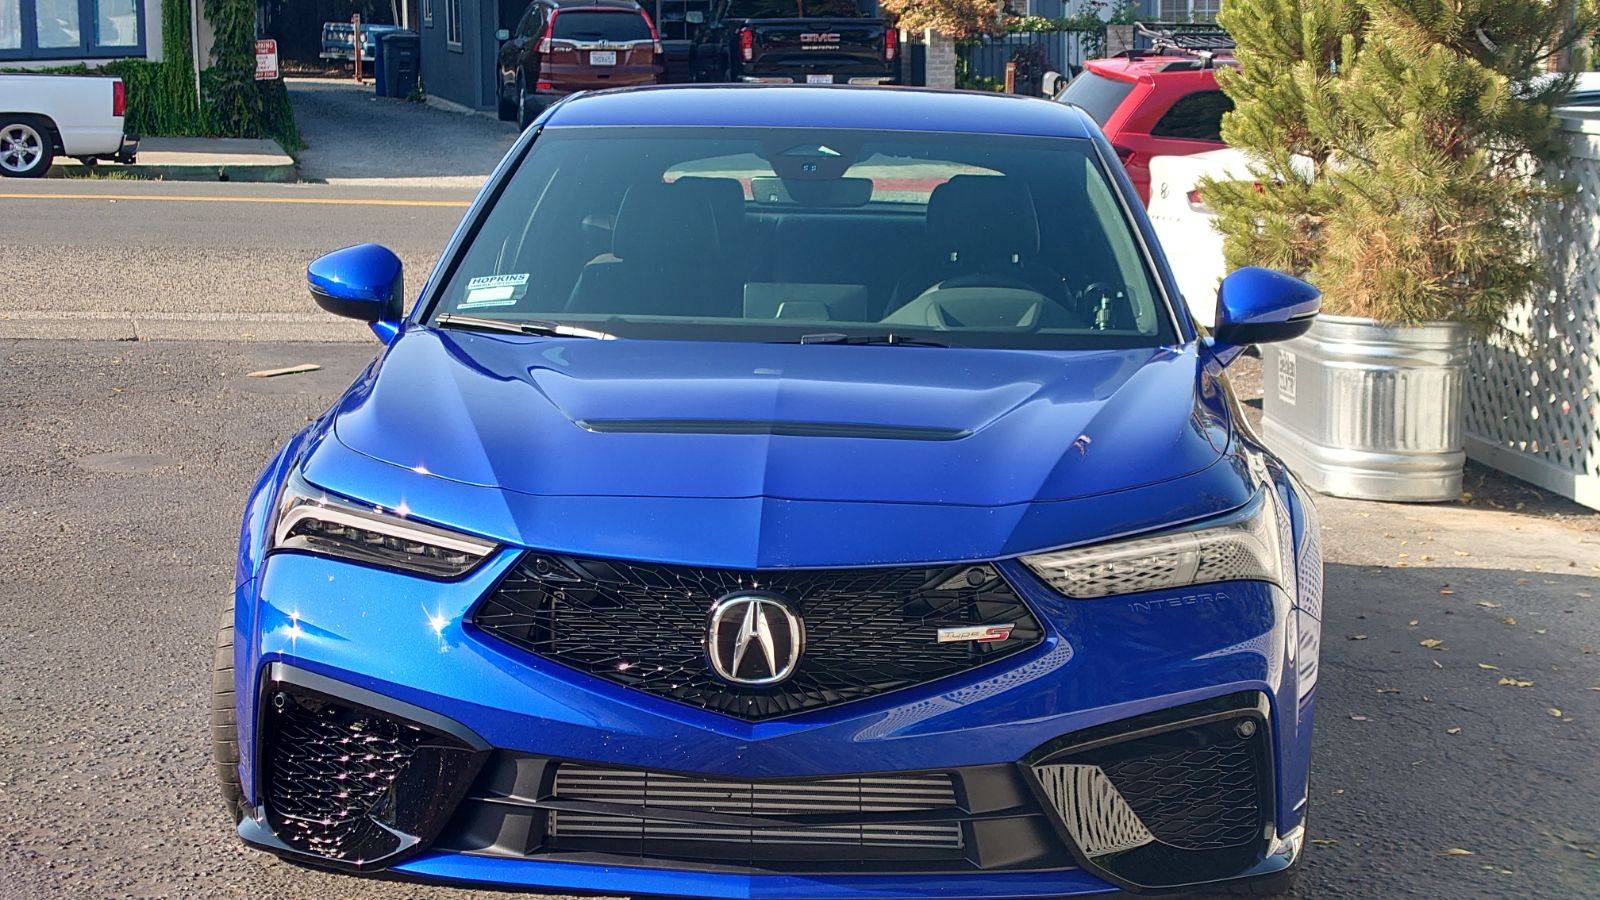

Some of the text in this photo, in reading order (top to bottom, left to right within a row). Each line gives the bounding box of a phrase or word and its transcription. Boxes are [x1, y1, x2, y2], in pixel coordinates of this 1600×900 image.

[800, 33, 841, 42] GMC
[472, 274, 525, 284] HOPKINS
[1128, 592, 1230, 613] INTEGRA
[943, 627, 1010, 643] Type S
